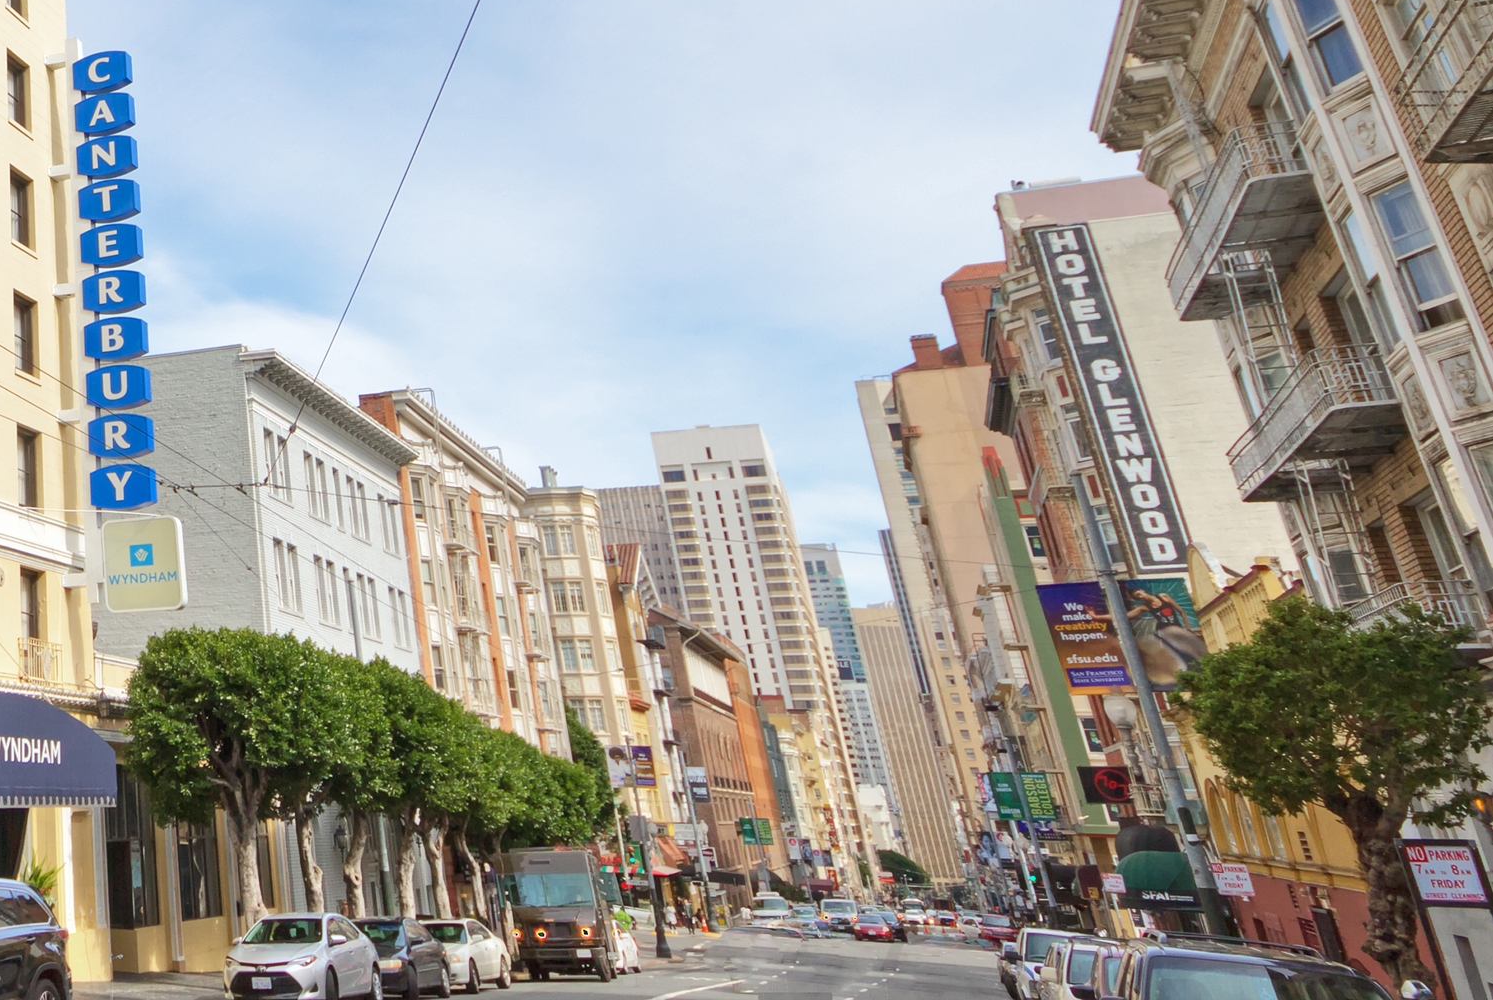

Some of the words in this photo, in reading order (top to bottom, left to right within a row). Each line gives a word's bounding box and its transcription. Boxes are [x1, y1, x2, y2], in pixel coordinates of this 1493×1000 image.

[87, 56, 133, 503] CANTERBURY
[1049, 228, 1108, 347] HOTEL
[1089, 358, 1178, 563] GLENWOOD
[108, 571, 177, 585] WYNDHAM
[1063, 602, 1084, 612] We
[1061, 611, 1093, 621] make
[1054, 621, 1107, 631] creativity
[1059, 632, 1107, 643] happen.
[1066, 653, 1119, 664] sfsu.edu
[1022, 777, 1044, 815] BABSON
[1035, 778, 1055, 816] COLLEGE
[1406, 846, 1425, 861] NO
[1428, 850, 1470, 861] PARKING
[1211, 863, 1223, 873] NO
[1430, 879, 1466, 889] FRIDAY
